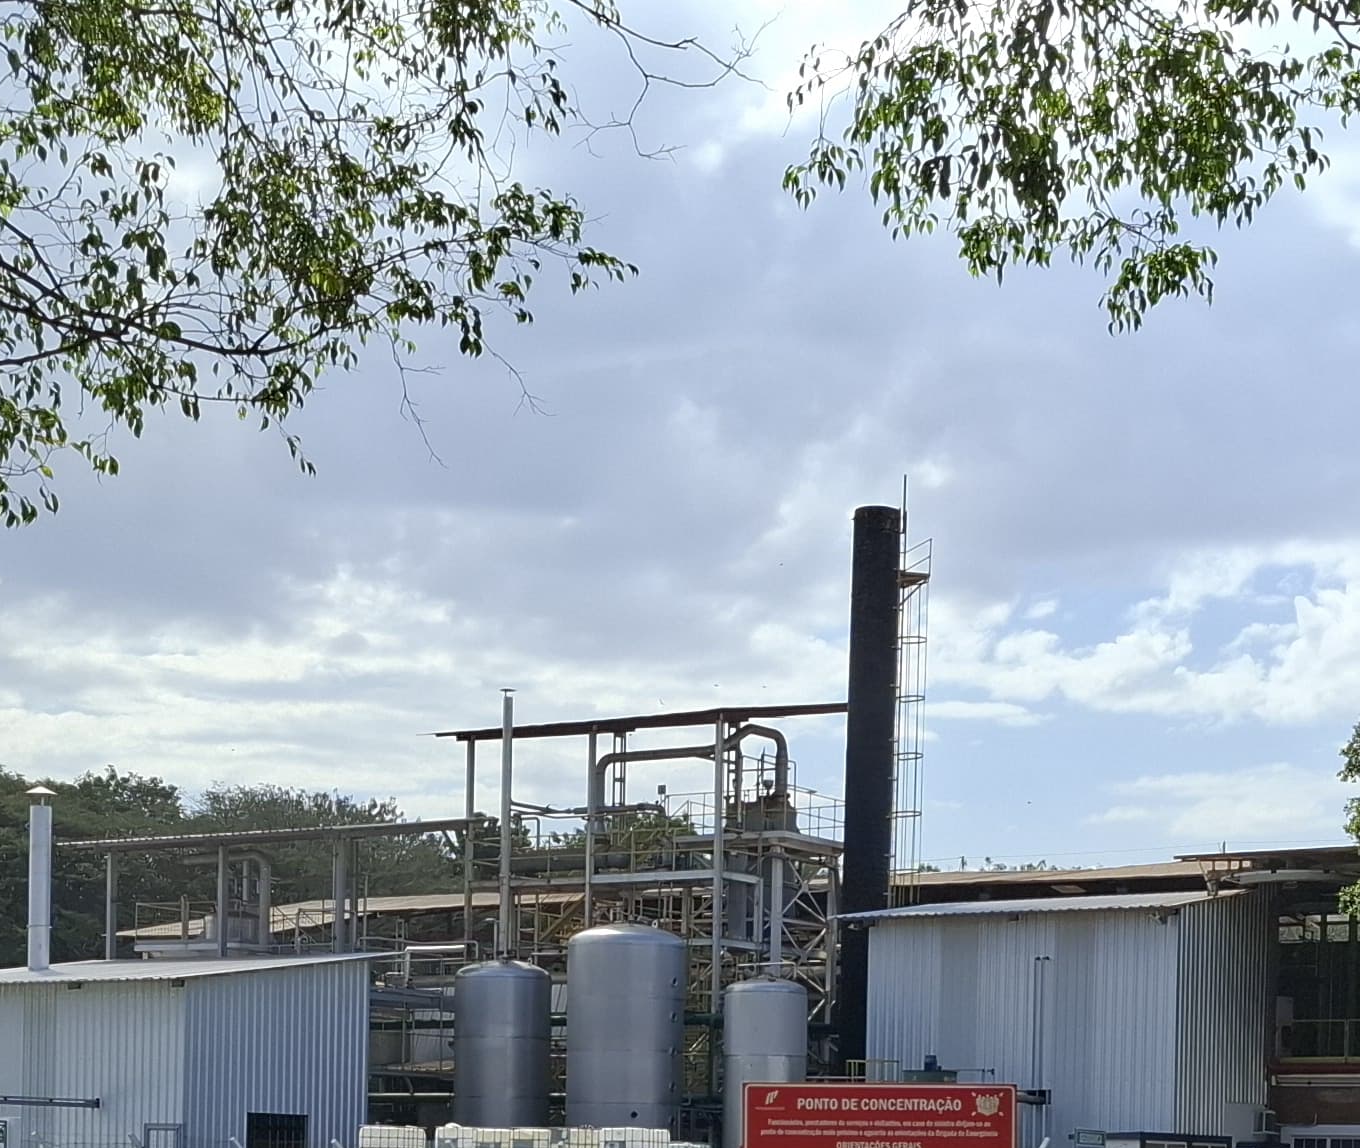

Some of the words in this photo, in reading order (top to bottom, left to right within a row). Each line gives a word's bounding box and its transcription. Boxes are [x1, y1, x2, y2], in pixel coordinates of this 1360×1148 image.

[797, 1098, 838, 1111] PONTO
[841, 1098, 858, 1111] DE
[861, 1096, 962, 1114] CONCENTRAÇÃO
